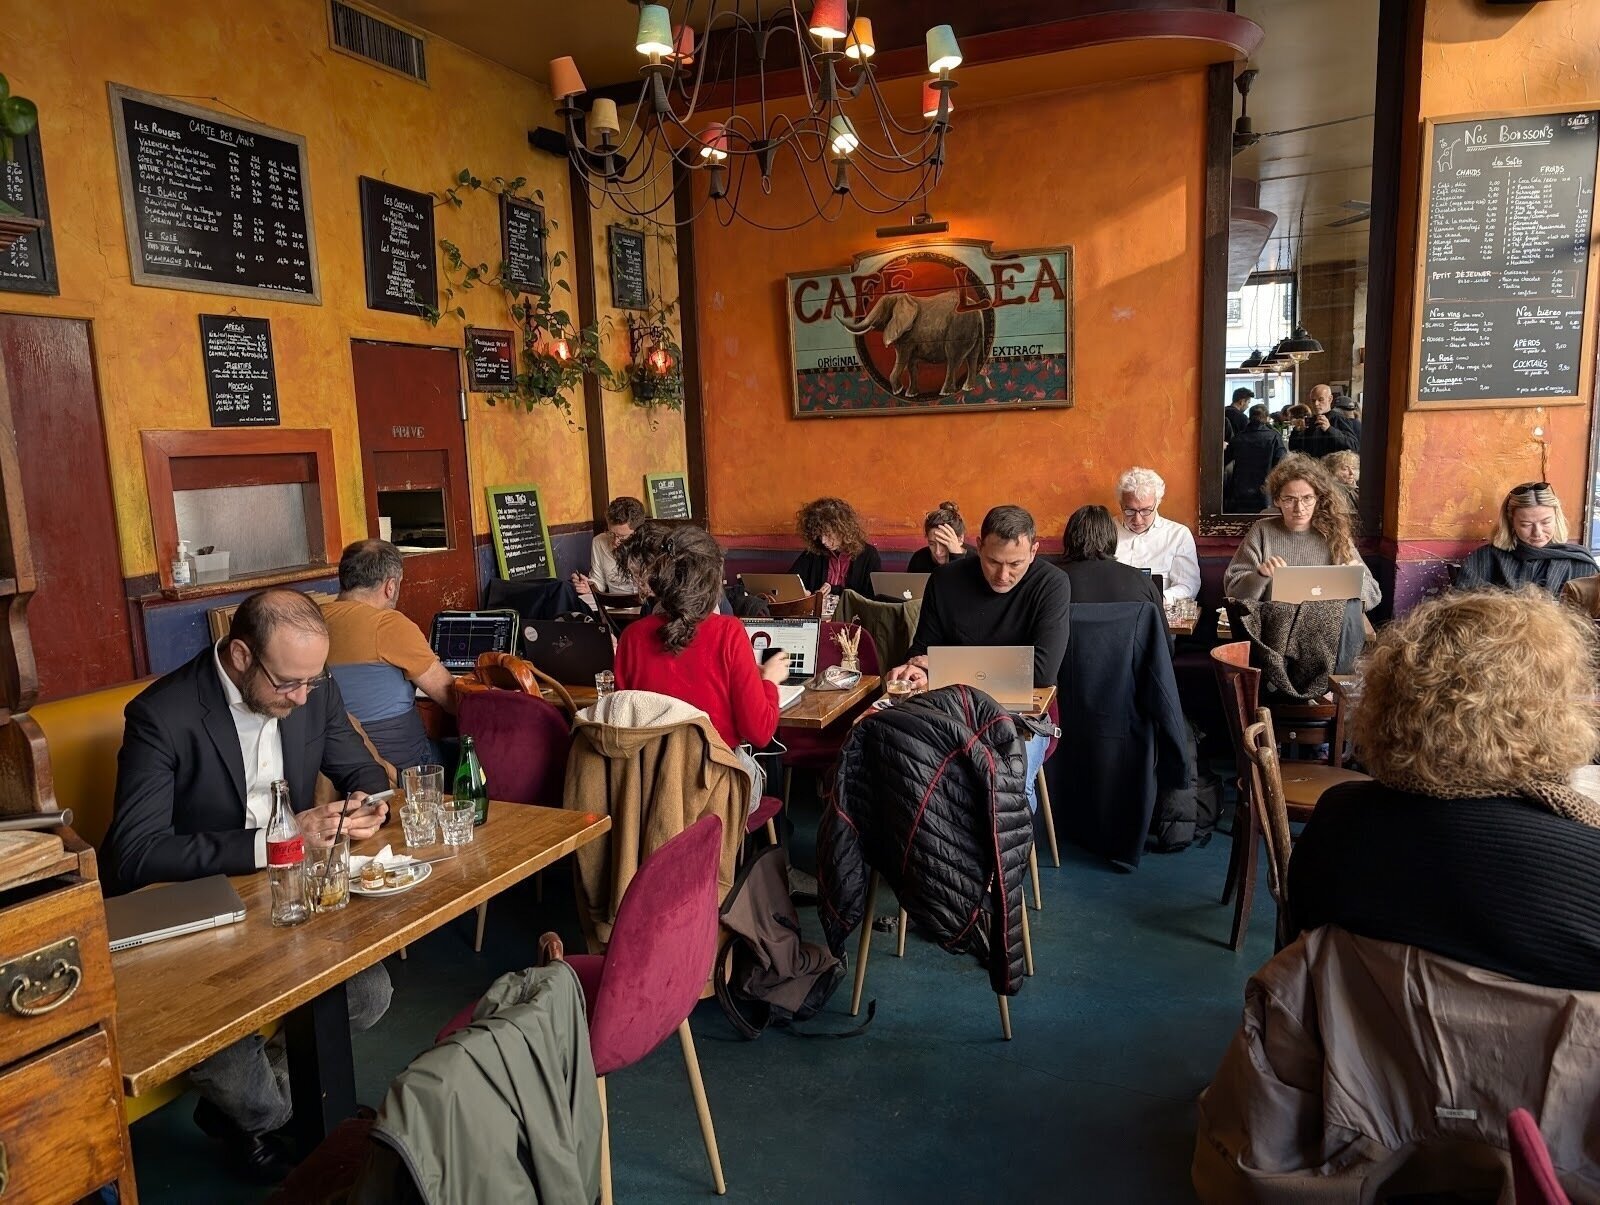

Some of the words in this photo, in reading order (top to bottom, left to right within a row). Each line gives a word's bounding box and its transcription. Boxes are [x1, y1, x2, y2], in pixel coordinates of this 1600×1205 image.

[1568, 117, 1590, 126] SALLE
[190, 120, 216, 137] CARTE
[220, 130, 233, 141] DES
[1465, 125, 1488, 145] Nos
[157, 186, 188, 200] BLANCS
[145, 230, 154, 240] LE
[1432, 272, 1452, 281] PETIT
[1455, 270, 1492, 279] DÉJEUNER
[1429, 308, 1445, 318] Nos
[1516, 306, 1533, 317] Nos
[992, 344, 1044, 356] EXTRACT
[1439, 354, 1454, 362] Rosé
[1426, 376, 1462, 386] Champagne
